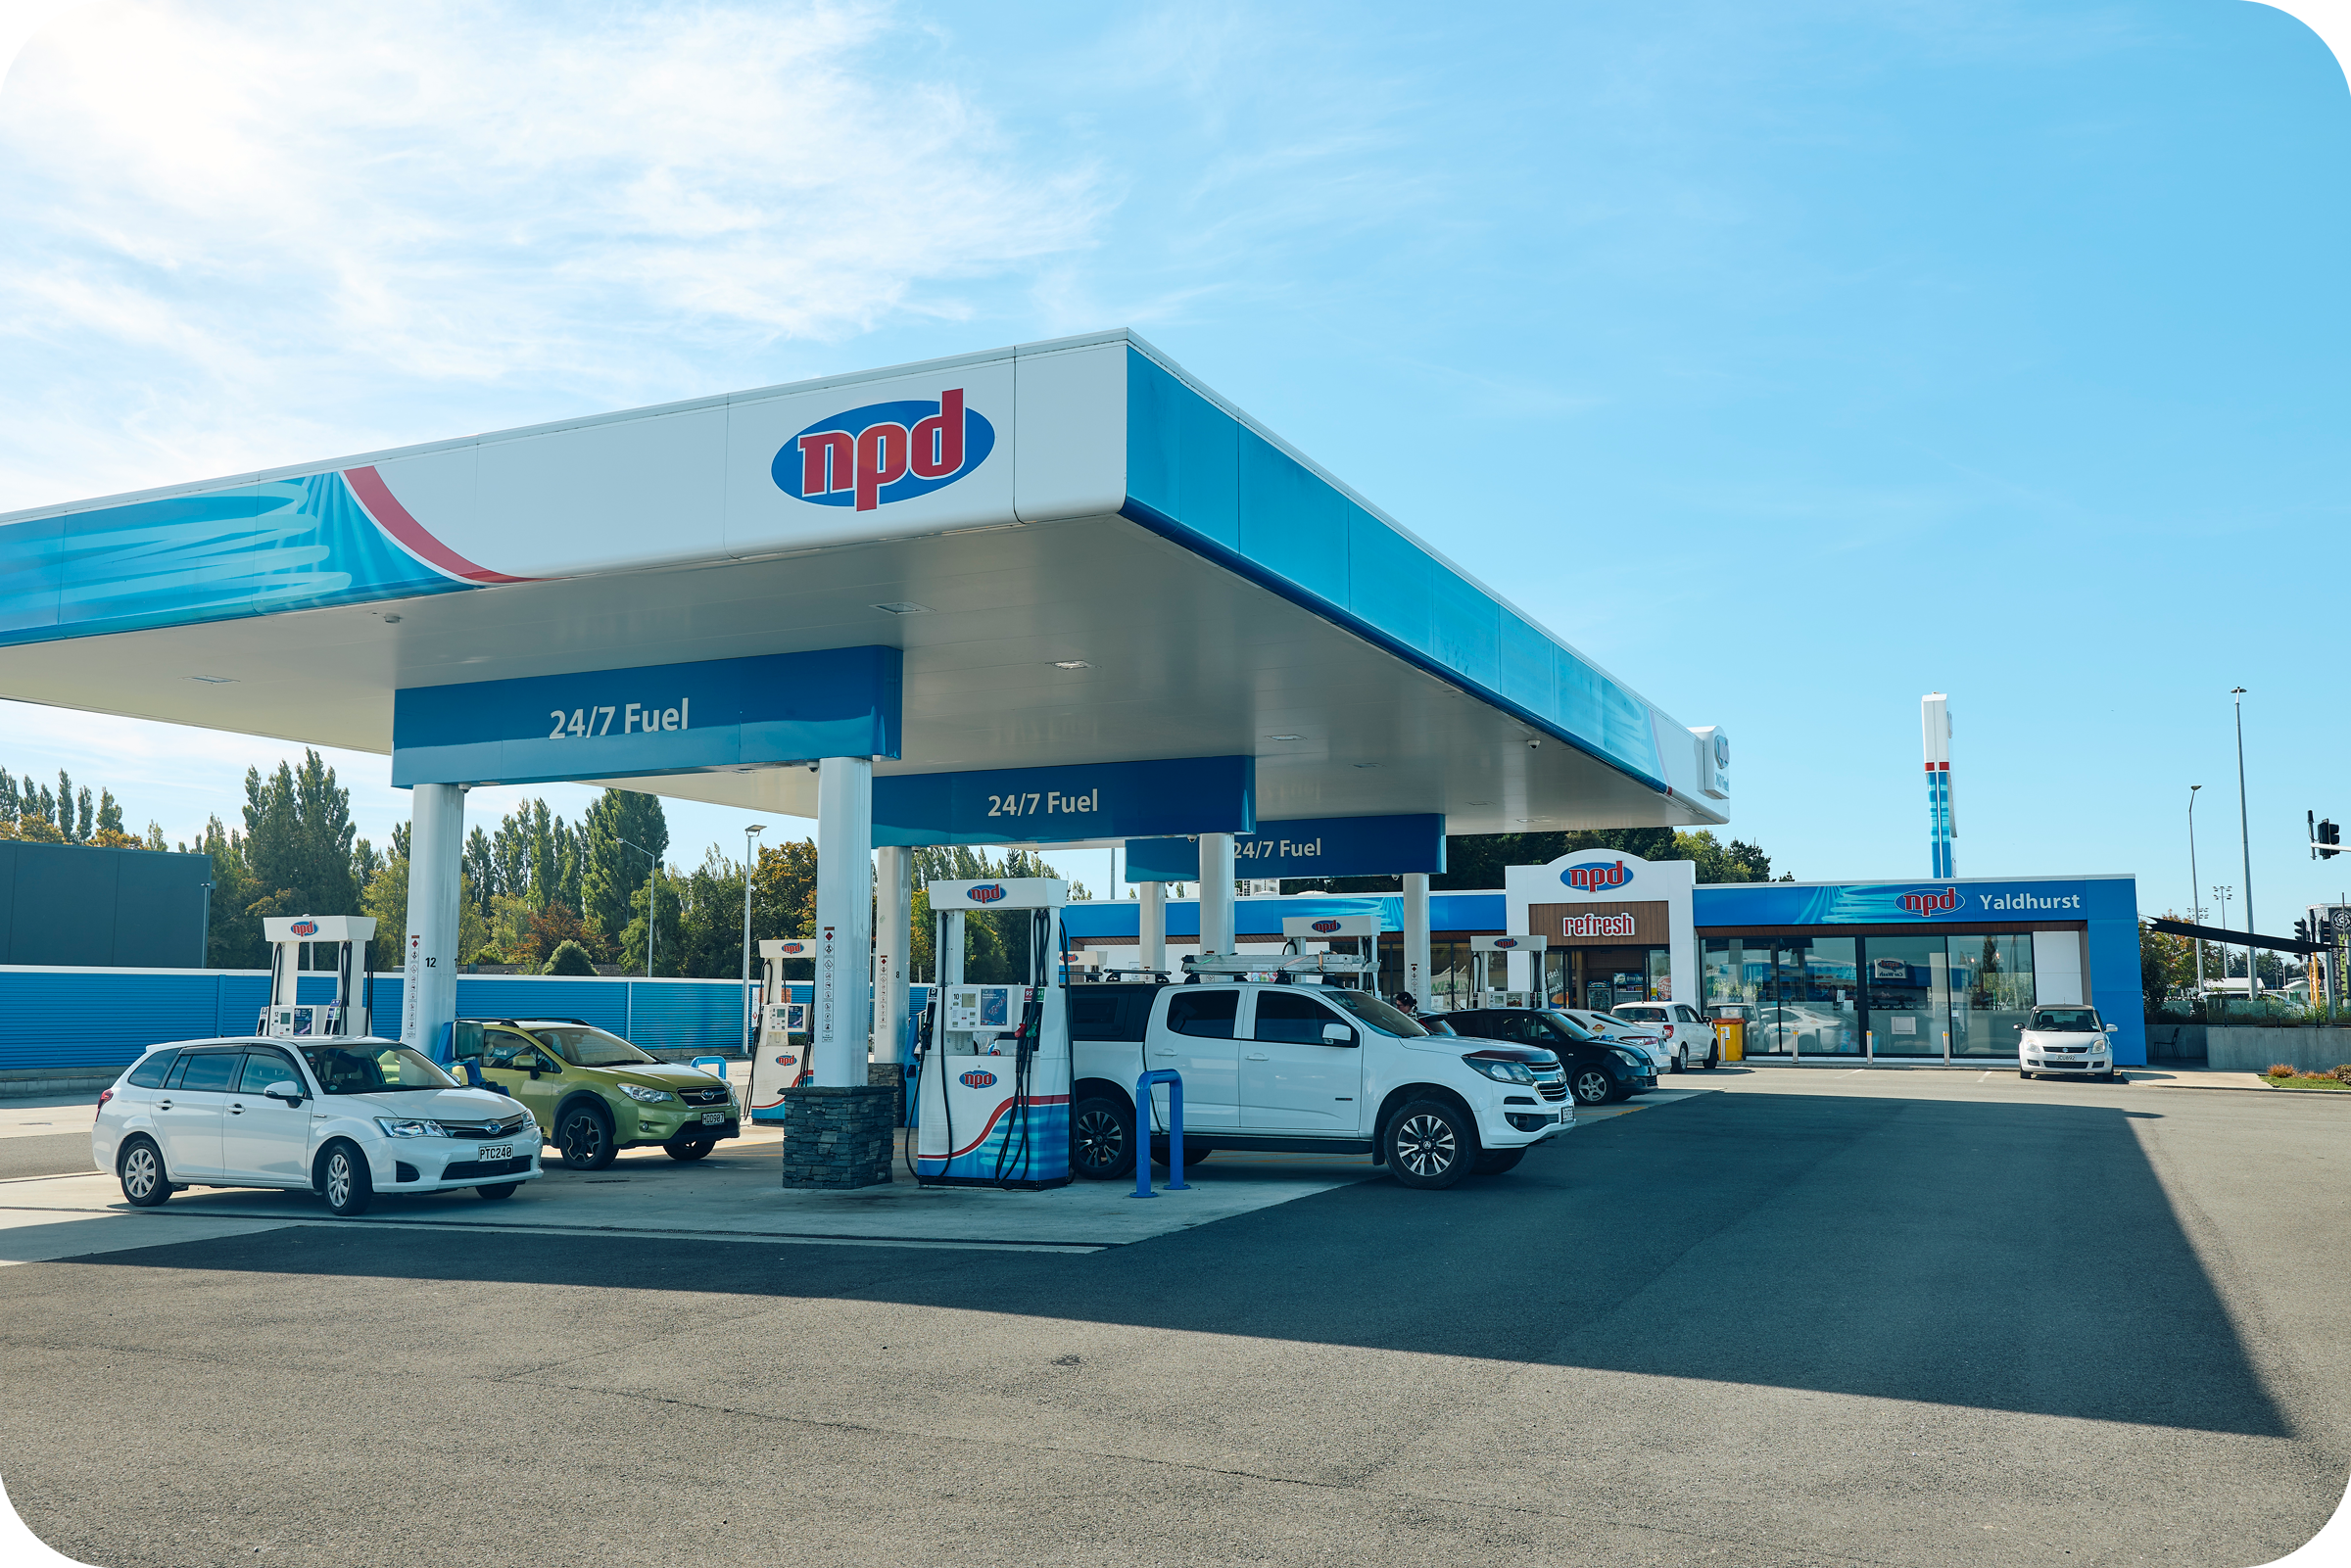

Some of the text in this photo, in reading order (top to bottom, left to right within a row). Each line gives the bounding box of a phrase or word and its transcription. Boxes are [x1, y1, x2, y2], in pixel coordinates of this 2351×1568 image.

[798, 387, 965, 512] npd
[549, 696, 689, 740] 24/7 Fuel
[987, 787, 1098, 817] 24/7 Fuel
[1233, 837, 1321, 859] 24/7 Fuel
[1568, 859, 1624, 893] npd
[970, 882, 1001, 904] npd
[1902, 886, 2081, 917] npd Yaldhurst
[292, 920, 313, 937] npd
[1315, 919, 1337, 933] npd
[1563, 913, 1635, 936] refresh
[783, 942, 800, 955] npd
[1497, 937, 1514, 949] npd
[425, 957, 437, 968] 12
[778, 1054, 795, 1067] npd
[964, 1071, 993, 1089] npd
[479, 1146, 512, 1161] PTC240
